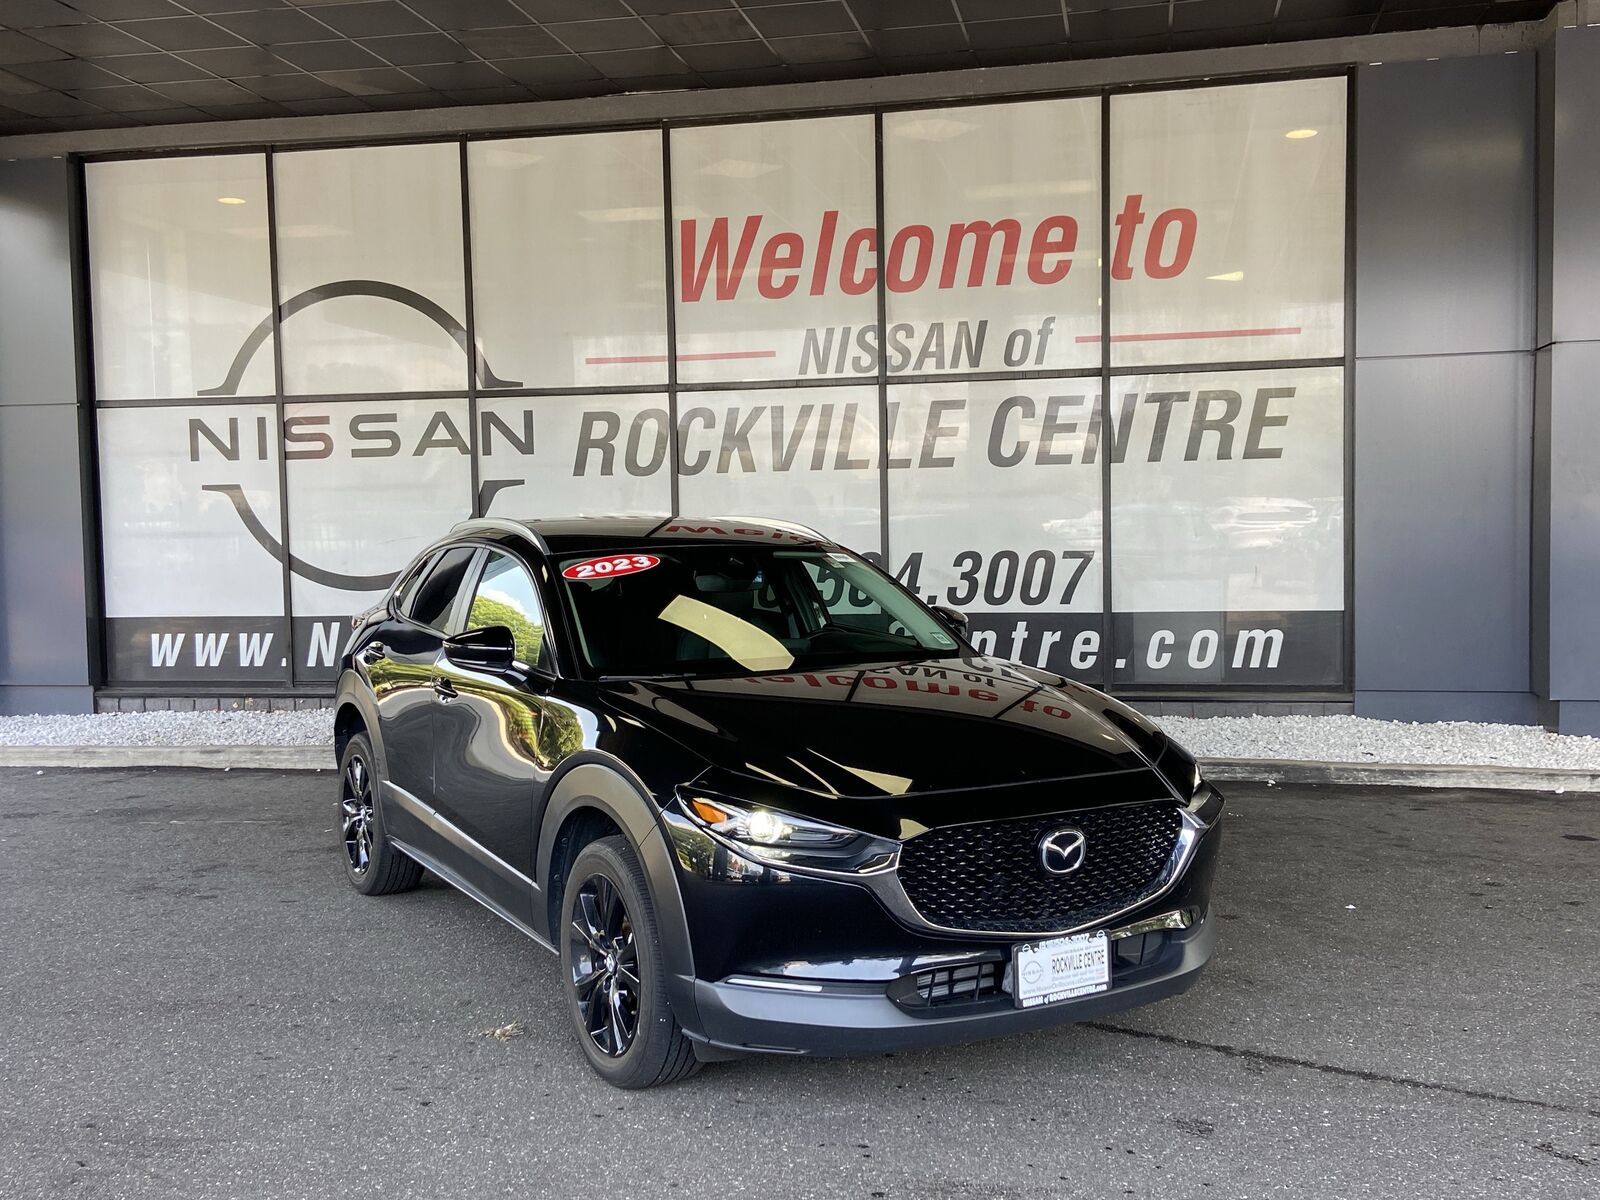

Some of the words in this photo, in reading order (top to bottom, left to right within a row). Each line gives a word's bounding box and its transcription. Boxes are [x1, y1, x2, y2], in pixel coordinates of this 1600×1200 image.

[680, 210, 1078, 303] Welcome
[1111, 194, 1198, 281] to
[798, 319, 988, 375] NISSAN
[1004, 316, 1056, 367] of
[188, 409, 534, 462] NISSAN
[573, 399, 967, 477] ROCKVILLE
[987, 387, 1297, 468] CENTRE
[575, 556, 653, 578] 2023
[1051, 954, 1083, 975] ROCKVILLE
[1084, 949, 1105, 968] CENTRE
